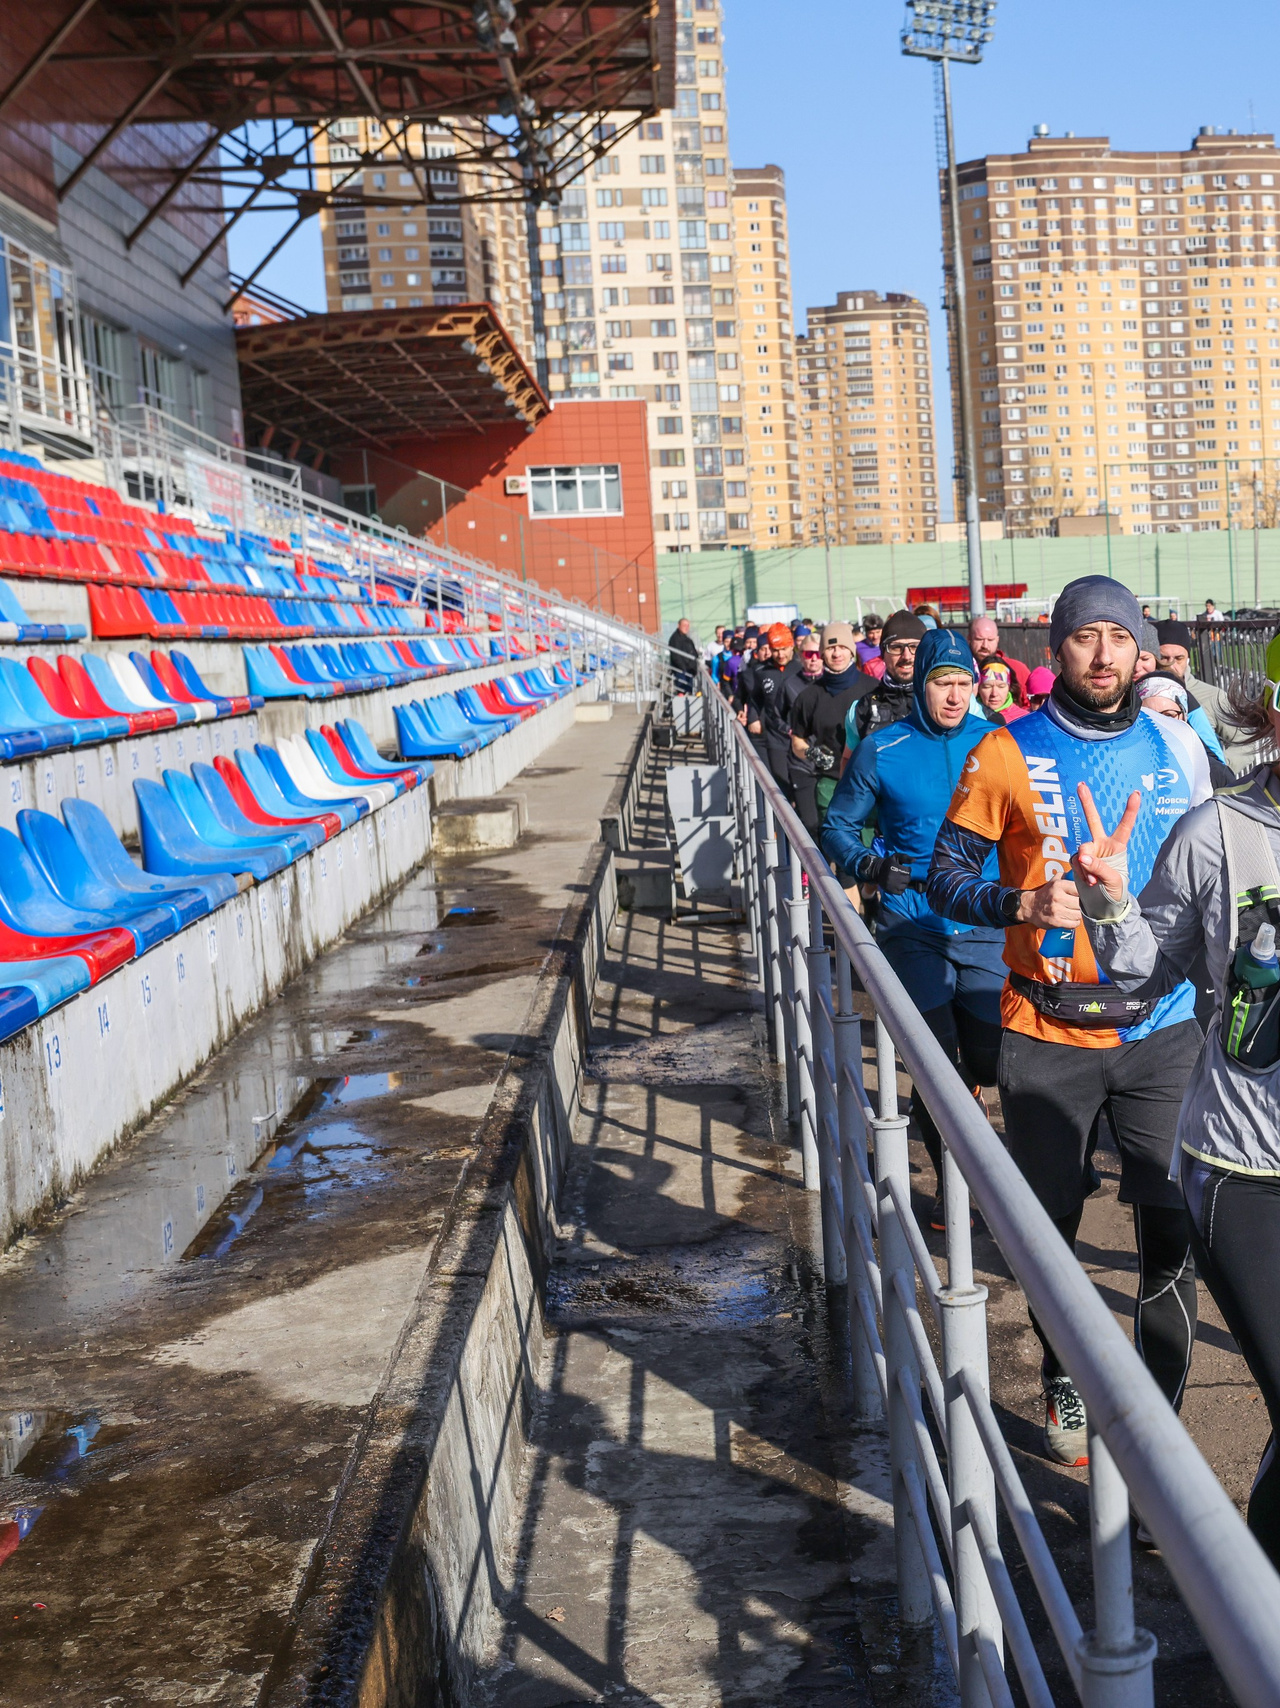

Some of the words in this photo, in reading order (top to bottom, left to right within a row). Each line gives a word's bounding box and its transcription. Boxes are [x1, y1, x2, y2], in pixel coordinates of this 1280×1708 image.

[1067, 796, 1077, 815] club
[176, 953, 186, 982] 16
[141, 975, 152, 1008] 15
[98, 1002, 110, 1037] 14
[46, 1034, 62, 1076] 13
